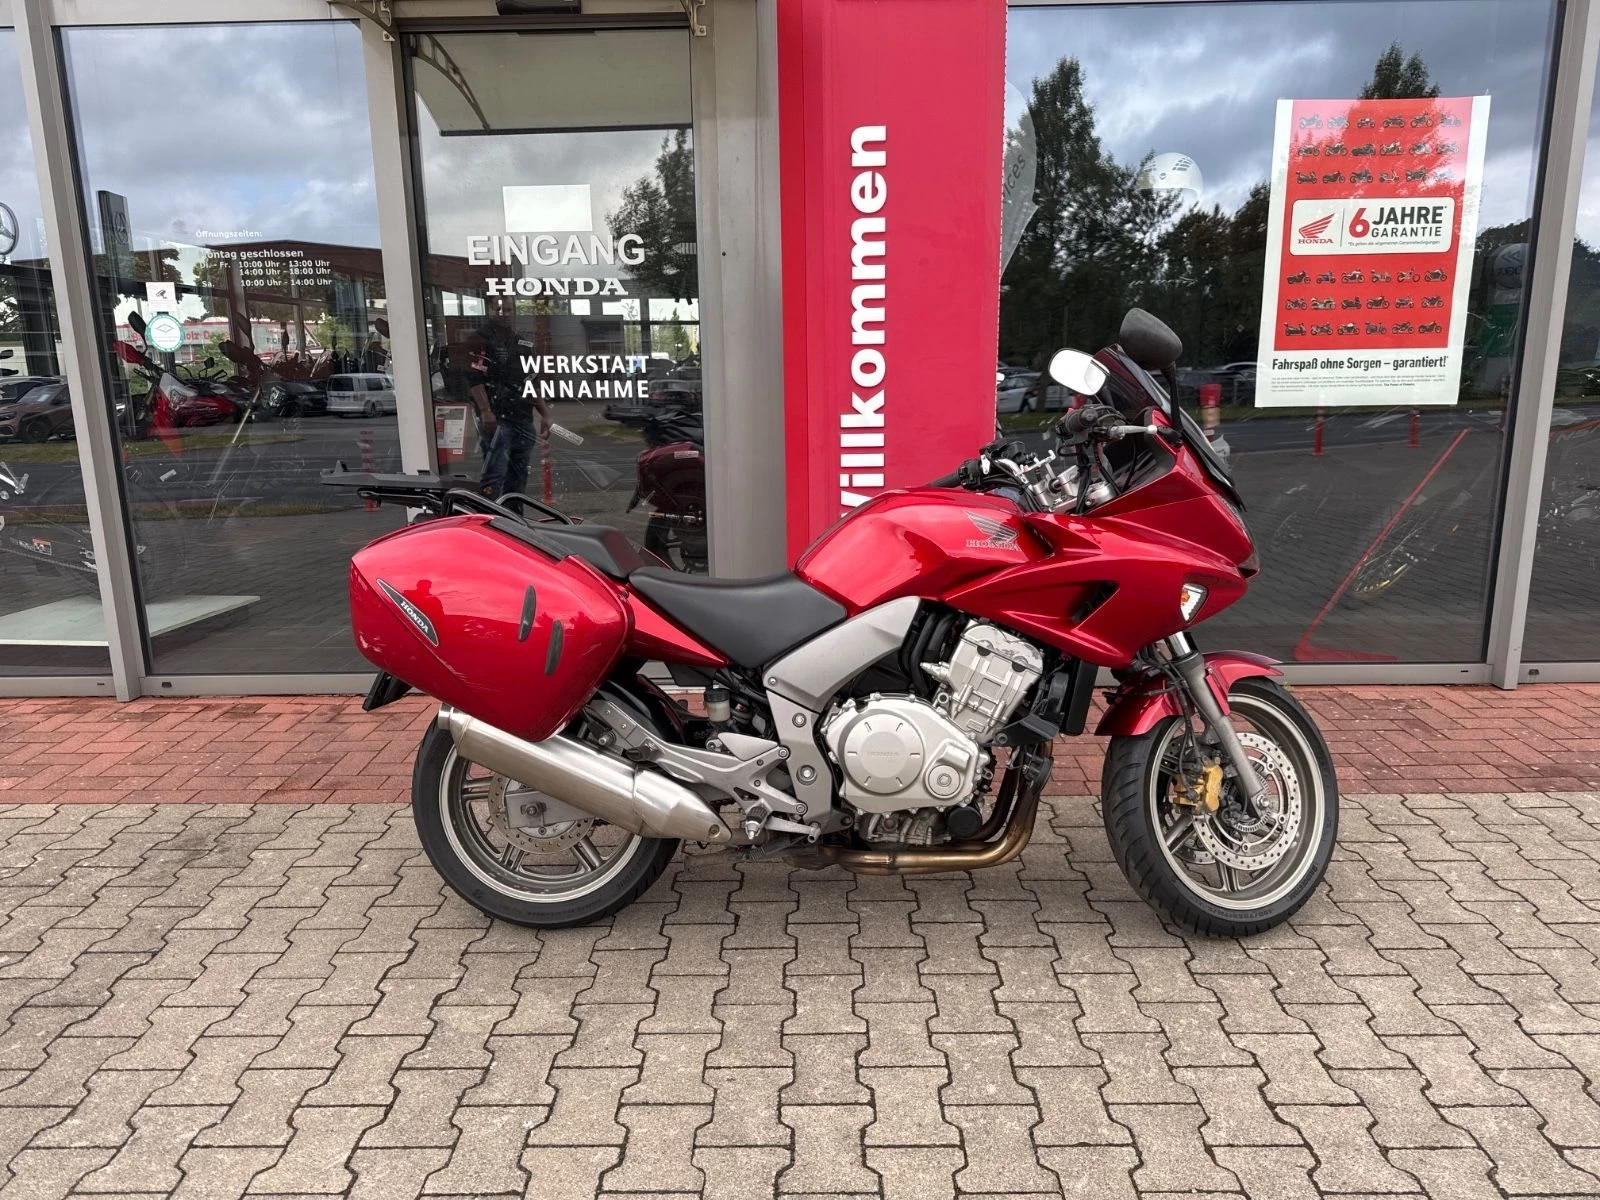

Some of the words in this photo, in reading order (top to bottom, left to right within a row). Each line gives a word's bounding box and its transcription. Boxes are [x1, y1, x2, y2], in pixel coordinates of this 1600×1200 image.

[1349, 207, 1370, 238] 6
[195, 230, 263, 239] Öffnungszeiten:
[1371, 226, 1442, 238] GARANTIE
[203, 250, 237, 260] ontag
[240, 249, 304, 260] geschlossen
[466, 233, 646, 266] EINGANG
[238, 260, 262, 268] 10:00
[265, 260, 280, 268] Uhr
[315, 259, 331, 267] Uhr
[239, 268, 263, 276] 14:00
[289, 267, 313, 275] 18:00
[315, 267, 331, 275] Uhr
[201, 280, 215, 288] Sa.
[240, 279, 264, 287] 10:00
[291, 278, 315, 286] 14:00
[485, 277, 629, 296] HONDA
[519, 355, 650, 374] WERKSTATT
[1272, 358, 1318, 372] Fahrspaß
[1320, 358, 1345, 369] ohne
[1347, 357, 1382, 371] Sorgen
[521, 379, 649, 398] ANNAHME
[966, 539, 1020, 551] HONDA
[400, 601, 429, 633] HONDA
